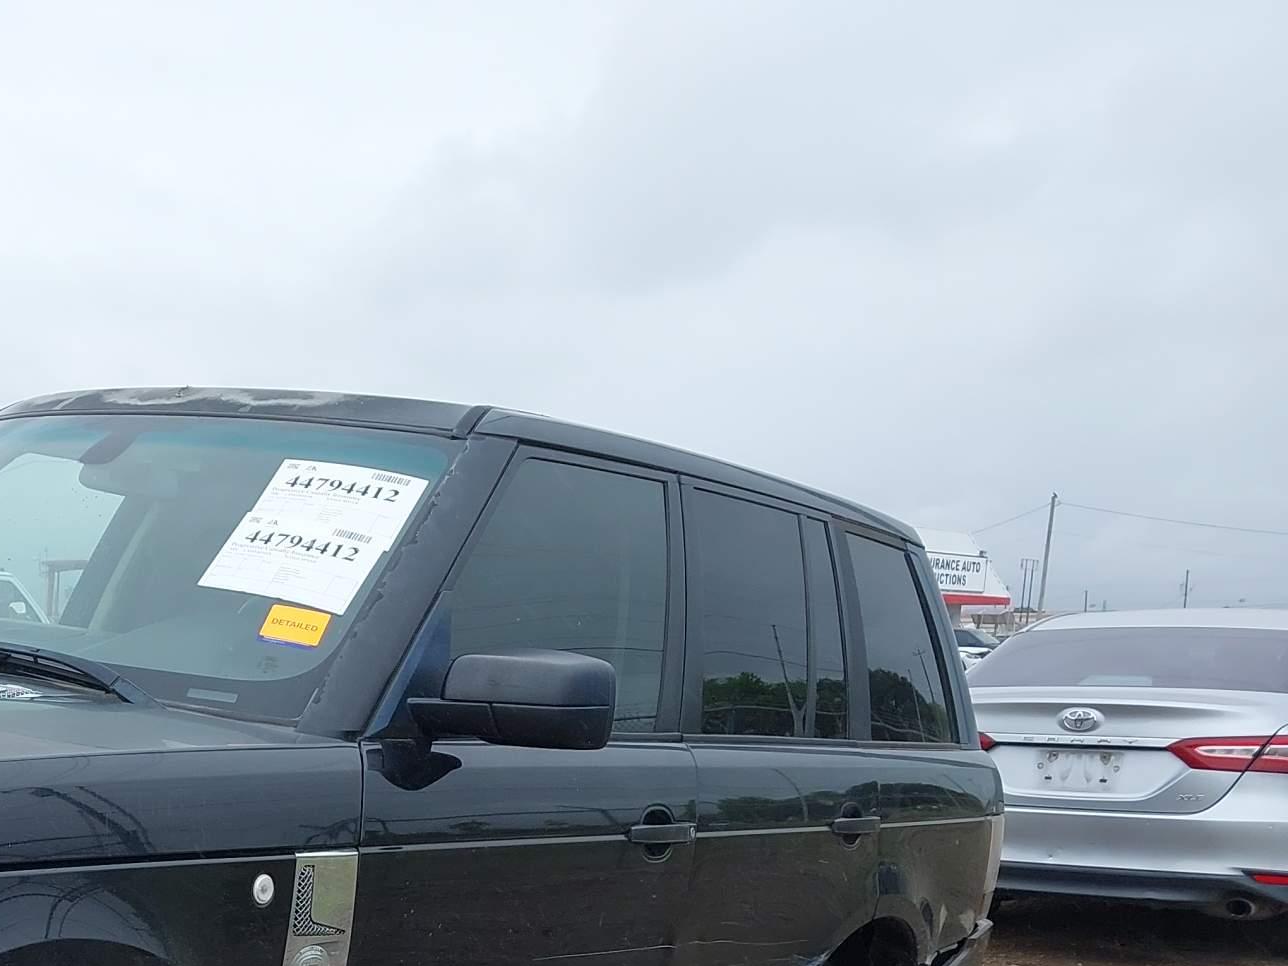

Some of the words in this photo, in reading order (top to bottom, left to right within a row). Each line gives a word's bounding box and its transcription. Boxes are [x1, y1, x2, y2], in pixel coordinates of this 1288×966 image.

[284, 475, 401, 503] 44794412
[244, 529, 361, 562] 44794412
[961, 560, 981, 573] AUTO
[271, 617, 319, 632] DETAILED
